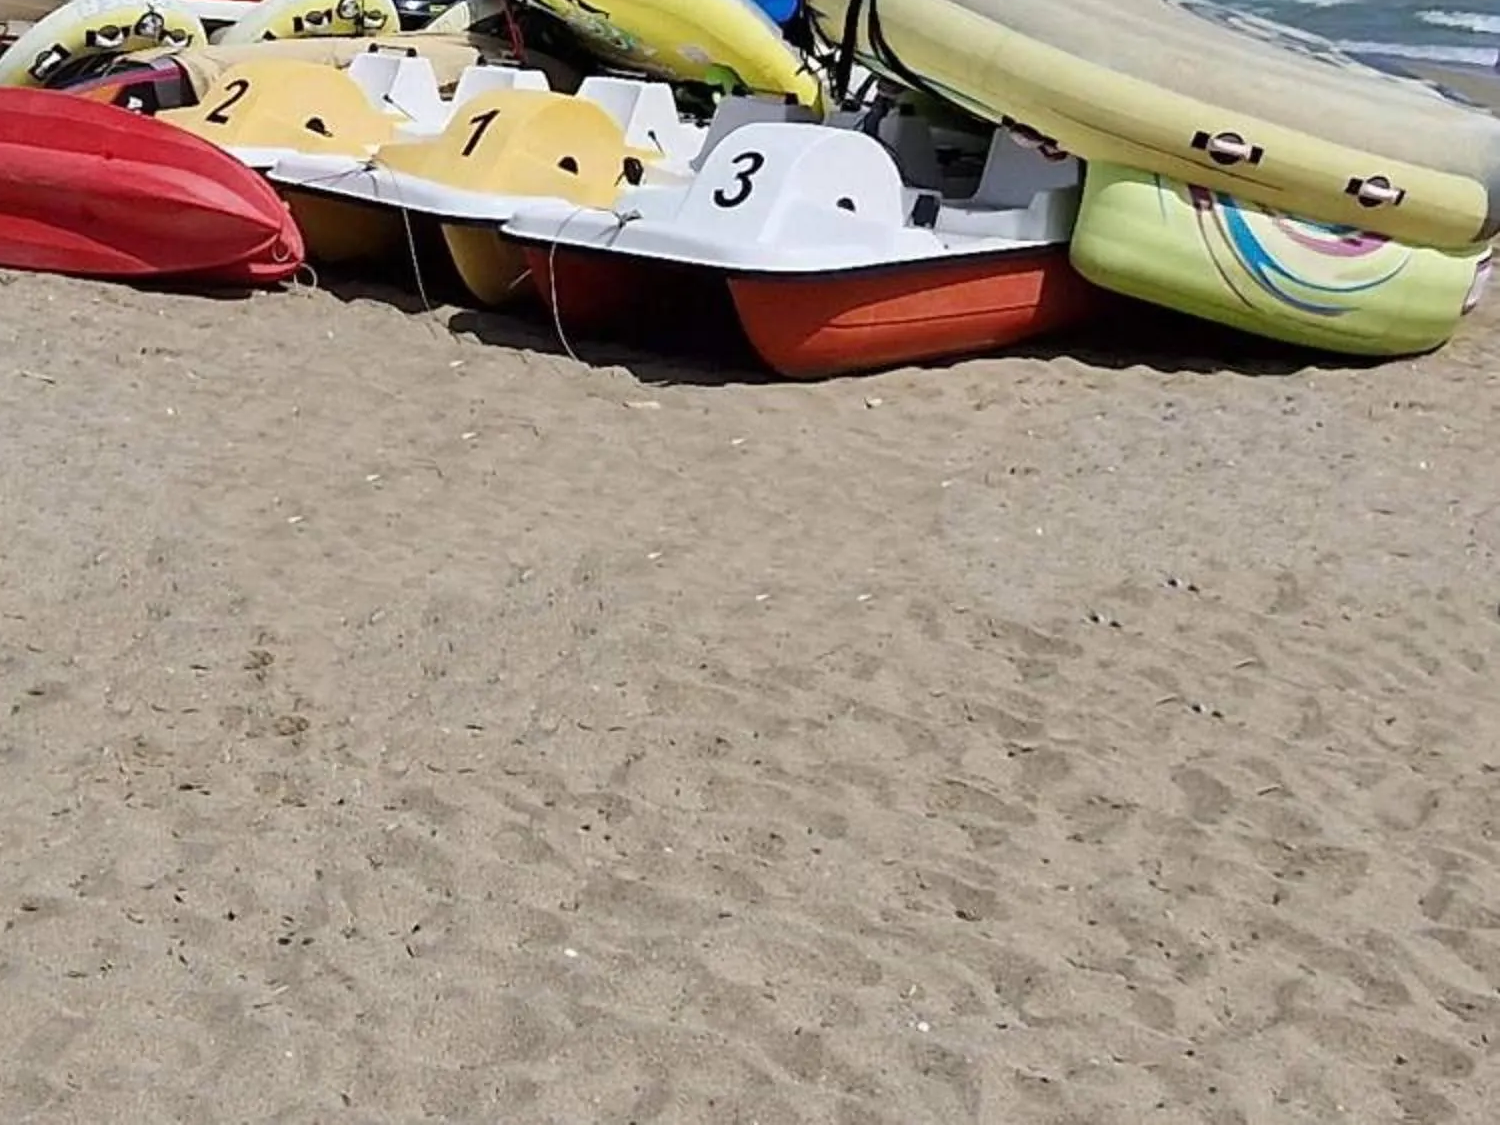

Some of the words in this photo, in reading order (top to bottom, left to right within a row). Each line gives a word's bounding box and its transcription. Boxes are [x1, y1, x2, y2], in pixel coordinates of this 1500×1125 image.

[205, 79, 249, 125] 2
[461, 109, 501, 157] 1
[713, 151, 765, 208] 3
